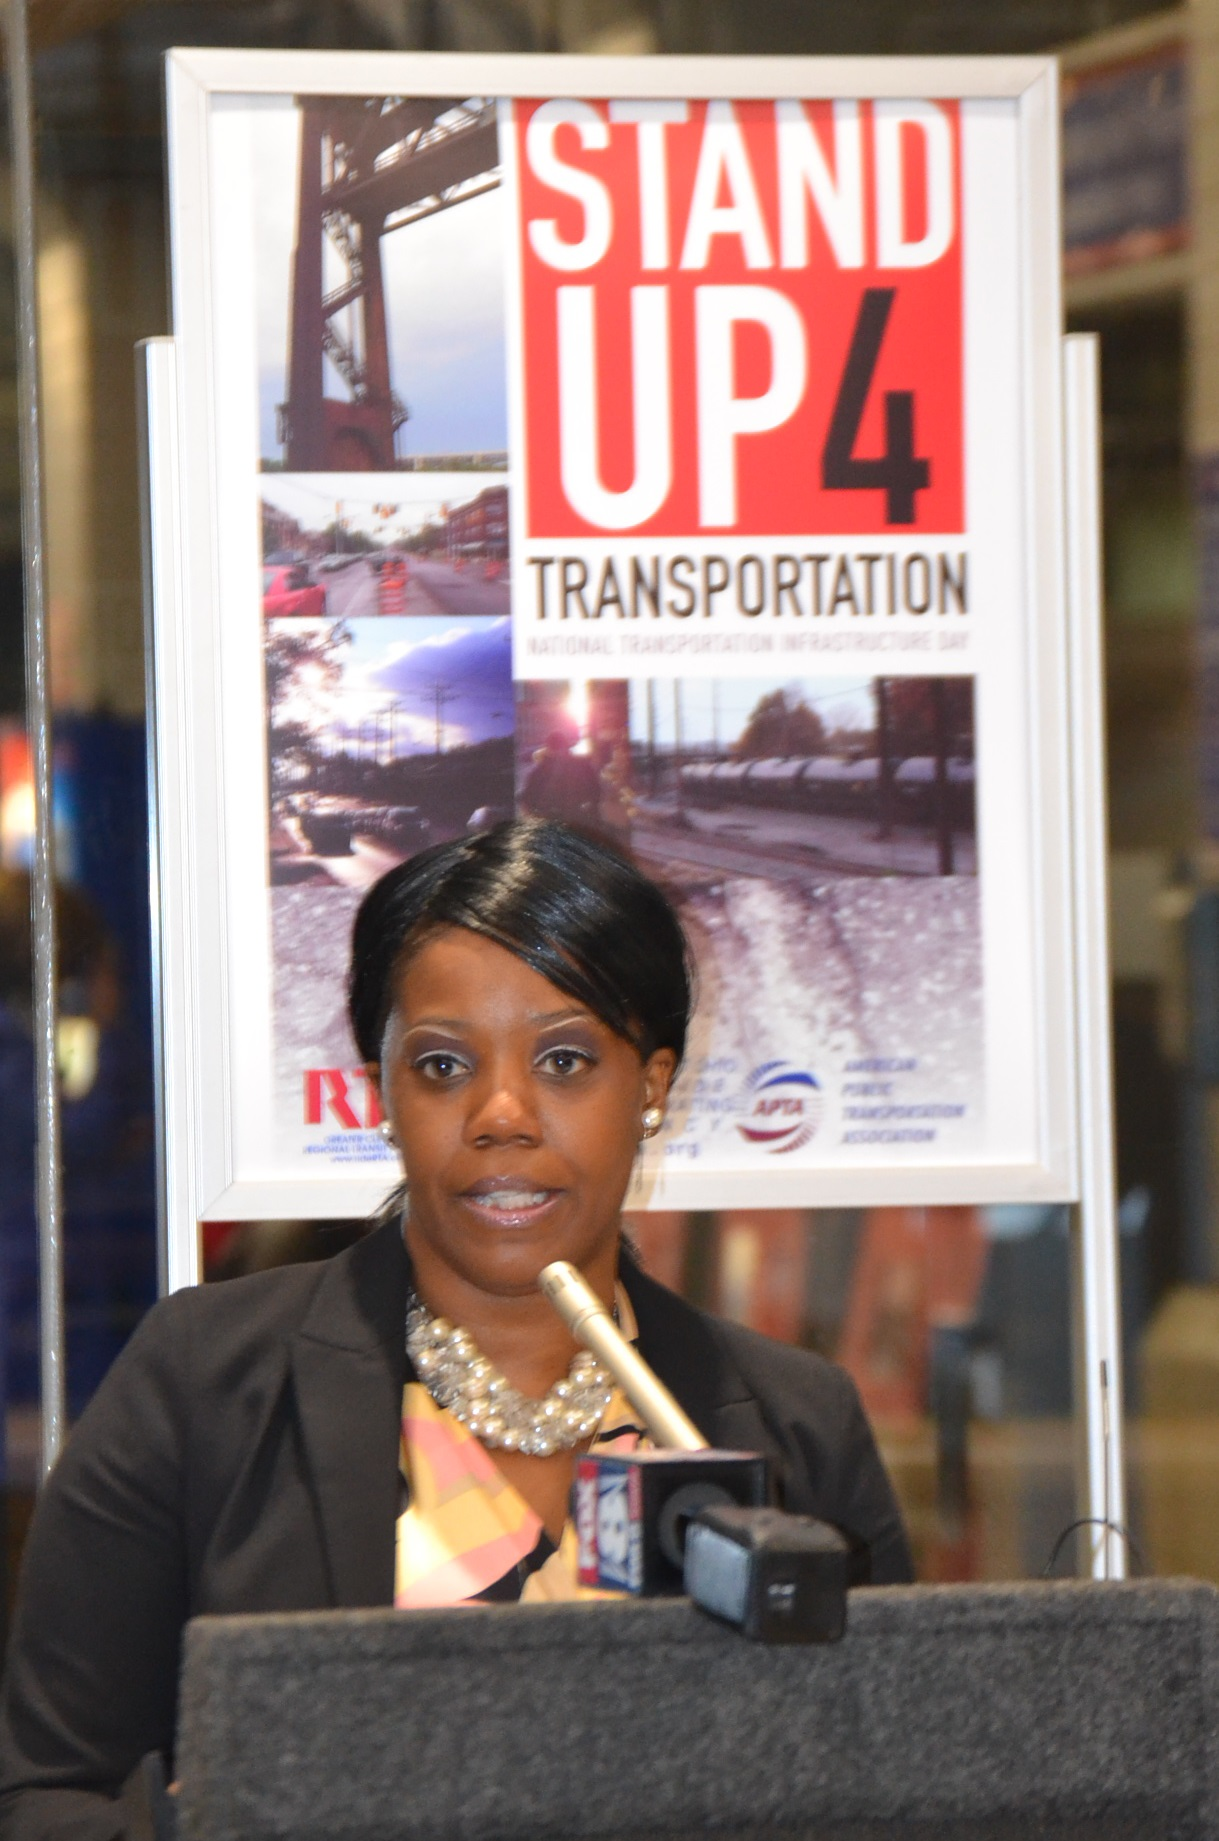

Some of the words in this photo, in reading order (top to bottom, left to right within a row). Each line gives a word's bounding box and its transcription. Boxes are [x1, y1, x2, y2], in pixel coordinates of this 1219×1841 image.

[526, 98, 955, 271] STAND
[556, 284, 808, 530] UP
[821, 286, 931, 525] 4
[526, 552, 968, 619] TRANSPORTATION
[527, 634, 613, 656] NATIONAL
[619, 632, 773, 655] TRANSPORTATION
[781, 630, 931, 653] INFRASTRUCTURE
[938, 629, 971, 652] DAY
[752, 1098, 804, 1116] APTA
